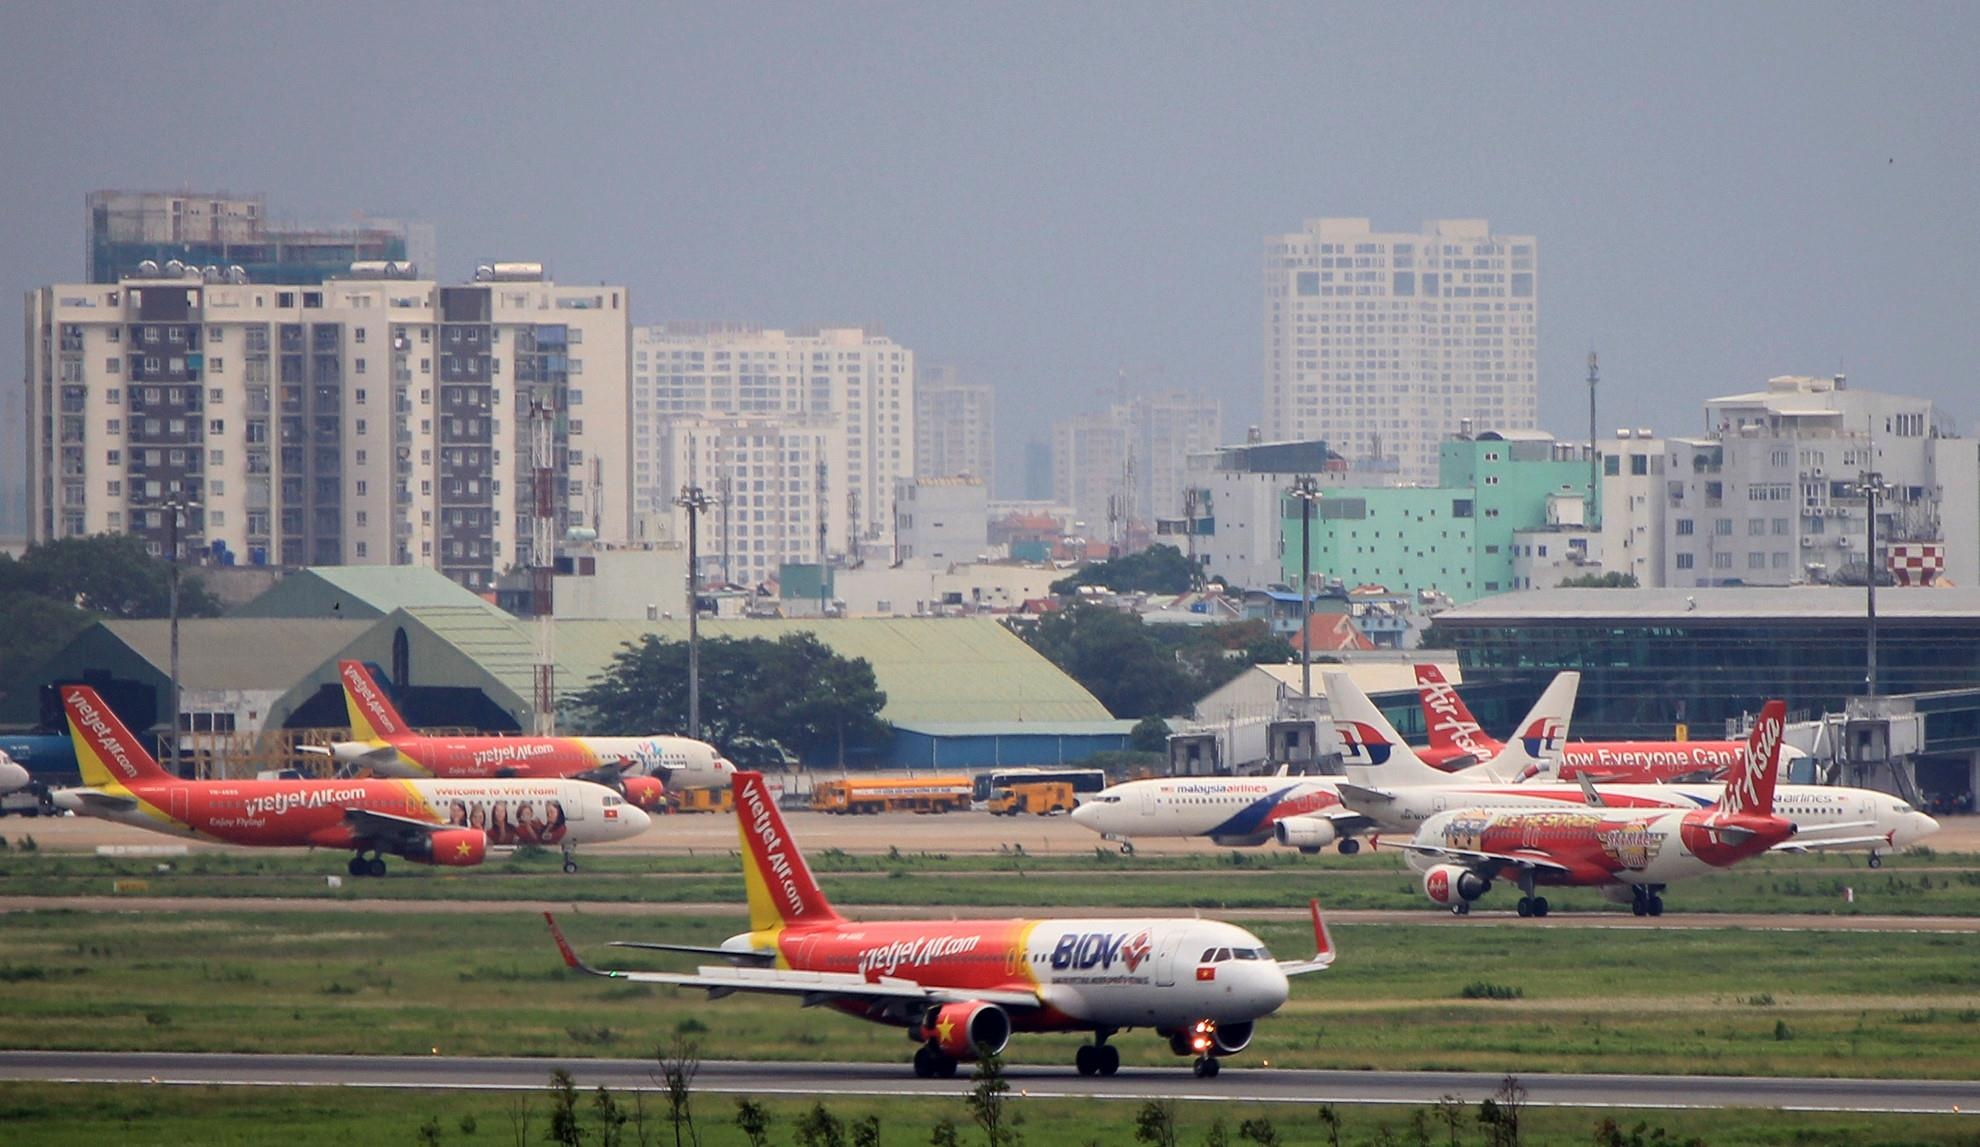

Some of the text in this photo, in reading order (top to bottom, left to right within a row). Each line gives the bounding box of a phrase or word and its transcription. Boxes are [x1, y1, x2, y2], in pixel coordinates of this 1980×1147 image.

[1598, 747, 1688, 770] Everyone
[1692, 747, 1731, 765] Can
[435, 787, 486, 796] Welcome
[489, 787, 500, 796] to
[1051, 933, 1128, 970] BIDV
